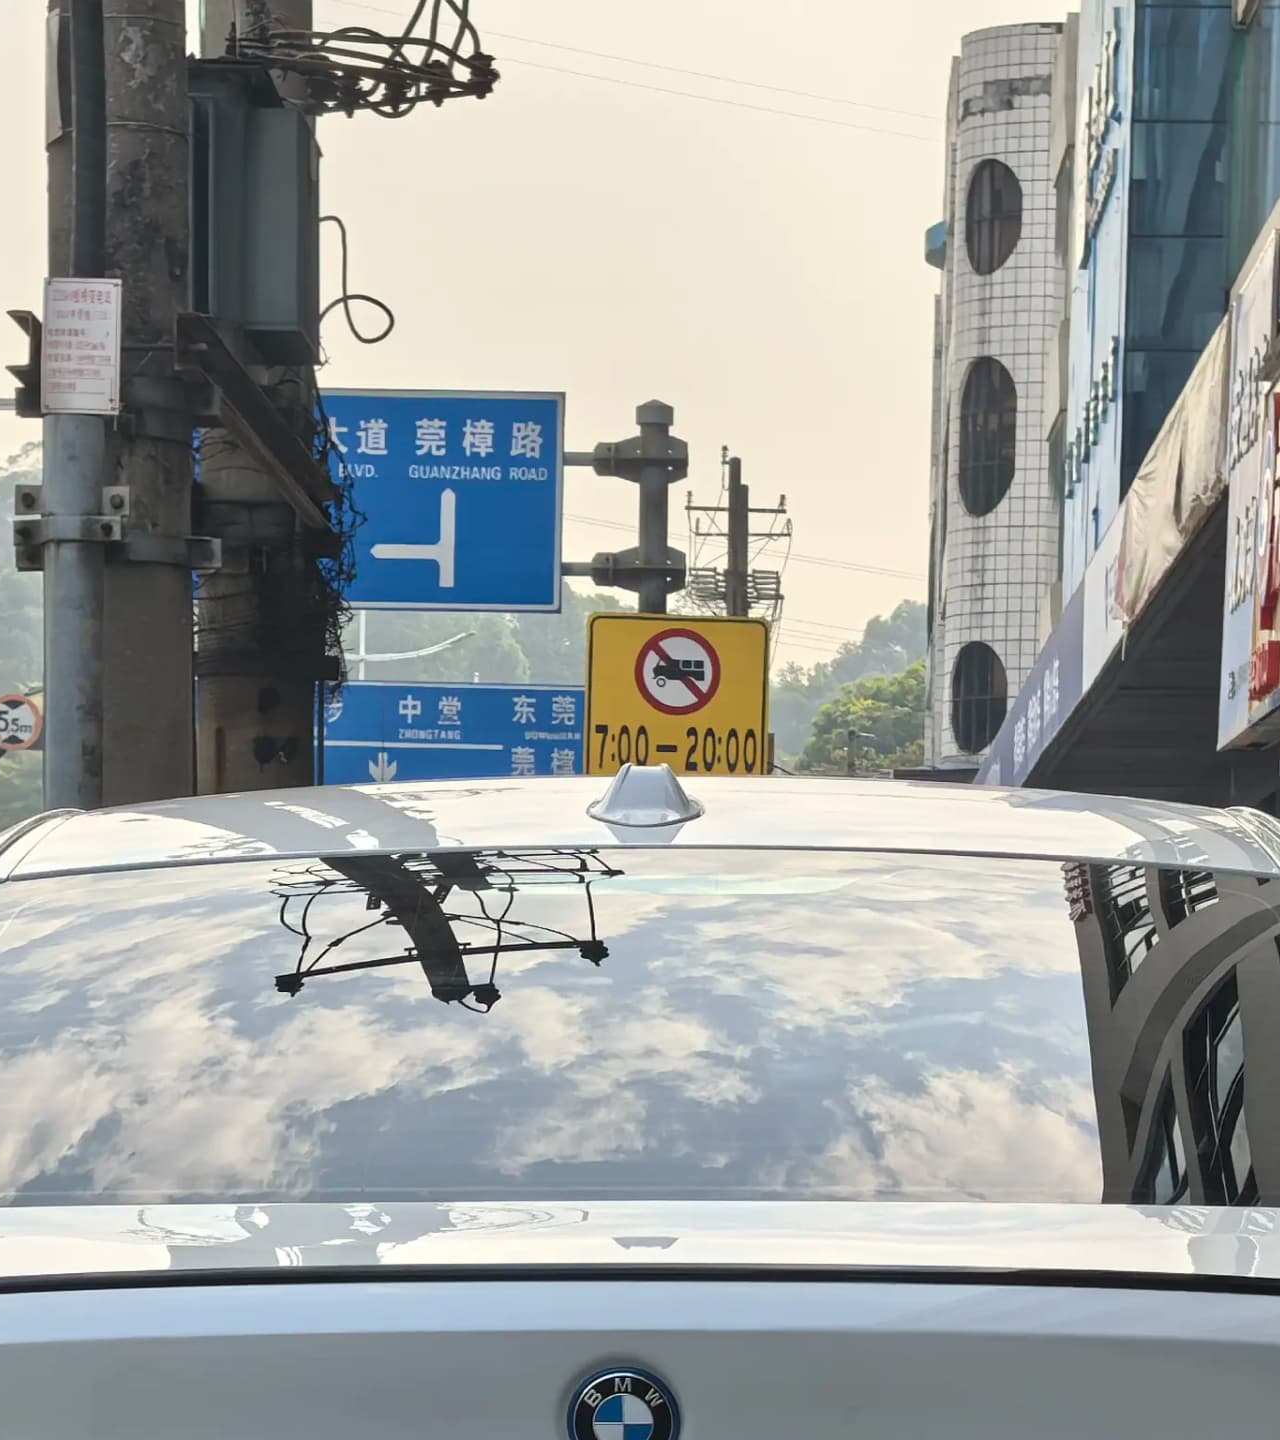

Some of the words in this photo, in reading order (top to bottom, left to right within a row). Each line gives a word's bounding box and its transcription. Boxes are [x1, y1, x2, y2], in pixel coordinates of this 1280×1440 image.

[415, 418, 544, 460] 莞樟路
[409, 466, 501, 481] GUANZHANG
[509, 467, 548, 481] ROAD
[398, 694, 462, 725] 中堂
[512, 695, 576, 726] 东莞
[398, 728, 461, 740] ZHONGTANG
[583, 1376, 664, 1410] BMW
